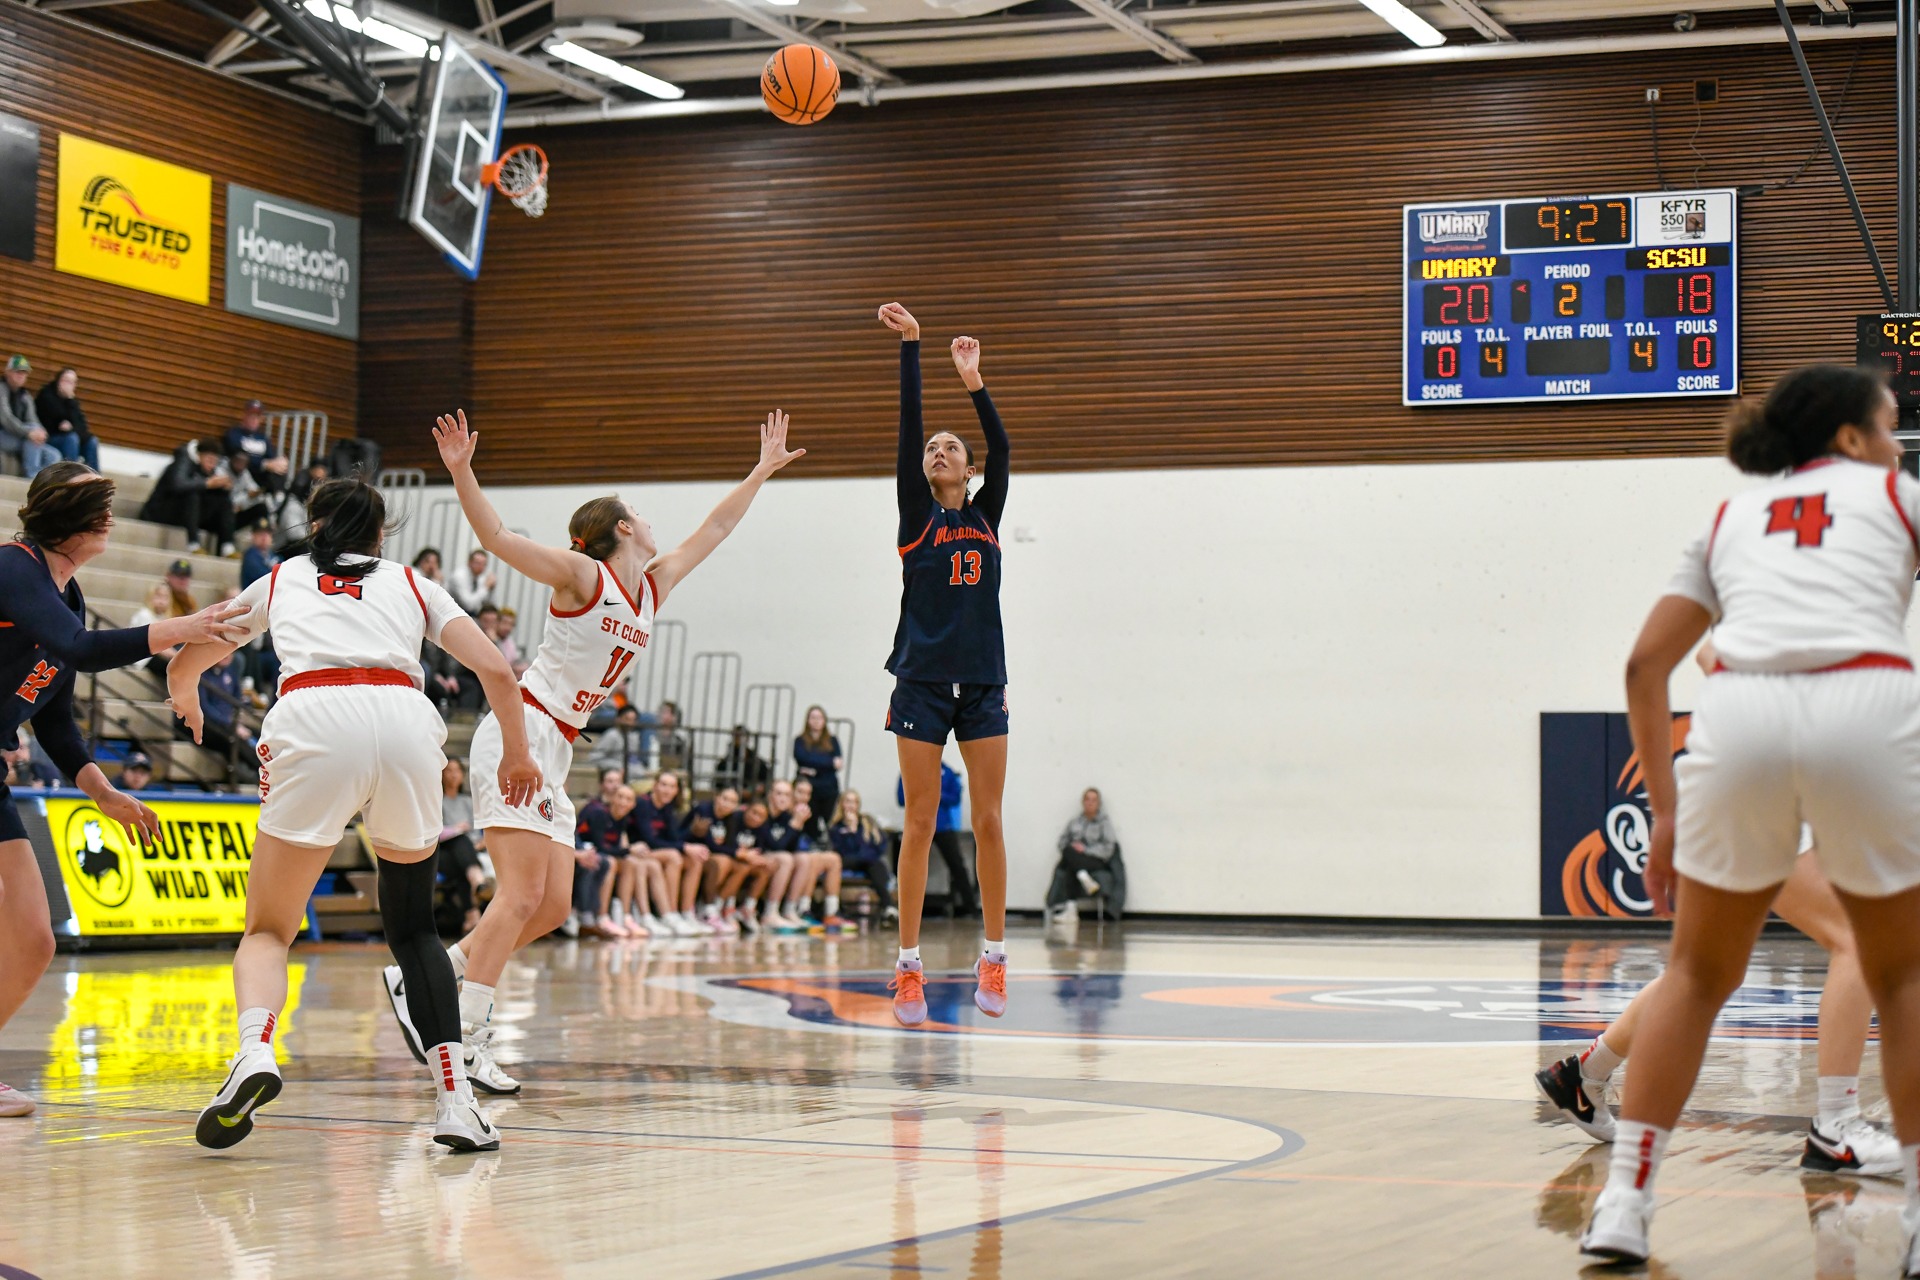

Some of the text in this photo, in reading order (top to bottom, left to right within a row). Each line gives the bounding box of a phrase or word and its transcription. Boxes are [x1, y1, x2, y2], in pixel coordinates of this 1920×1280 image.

[79, 206, 191, 253] TRUSTED
[1423, 214, 1486, 238] UMARY
[1537, 202, 1626, 243] 9:27
[1661, 213, 1684, 226] 550
[126, 244, 135, 259] &
[140, 249, 181, 270] AUTO
[237, 225, 350, 284] Hometown
[1646, 247, 1707, 269] SCSU
[1422, 257, 1496, 279] UMARY
[1544, 264, 1591, 279] PERIOD
[1440, 284, 1489, 324] 20
[1559, 284, 1577, 315] 2
[1677, 275, 1712, 314] 18
[1421, 329, 1462, 345] FOULS
[1475, 328, 1510, 342] T.O.L.
[1524, 323, 1613, 341] PLAYER FOUL
[1624, 322, 1660, 336] T.O.L.
[1675, 319, 1718, 334] FOULS
[1438, 346, 1456, 377] 0
[1485, 347, 1503, 373] 4
[1634, 341, 1653, 367] 4
[1693, 336, 1712, 368] 0
[1421, 383, 1463, 399] SCORE
[1545, 379, 1591, 395] MATCH
[1677, 375, 1720, 390] SCORE
[1764, 492, 1833, 548] 4
[949, 550, 982, 585] 13
[600, 617, 621, 637] ST.
[599, 645, 635, 688] 11
[15, 659, 59, 704] 22
[136, 820, 258, 861] BUFFAL
[146, 870, 210, 899] WILD
